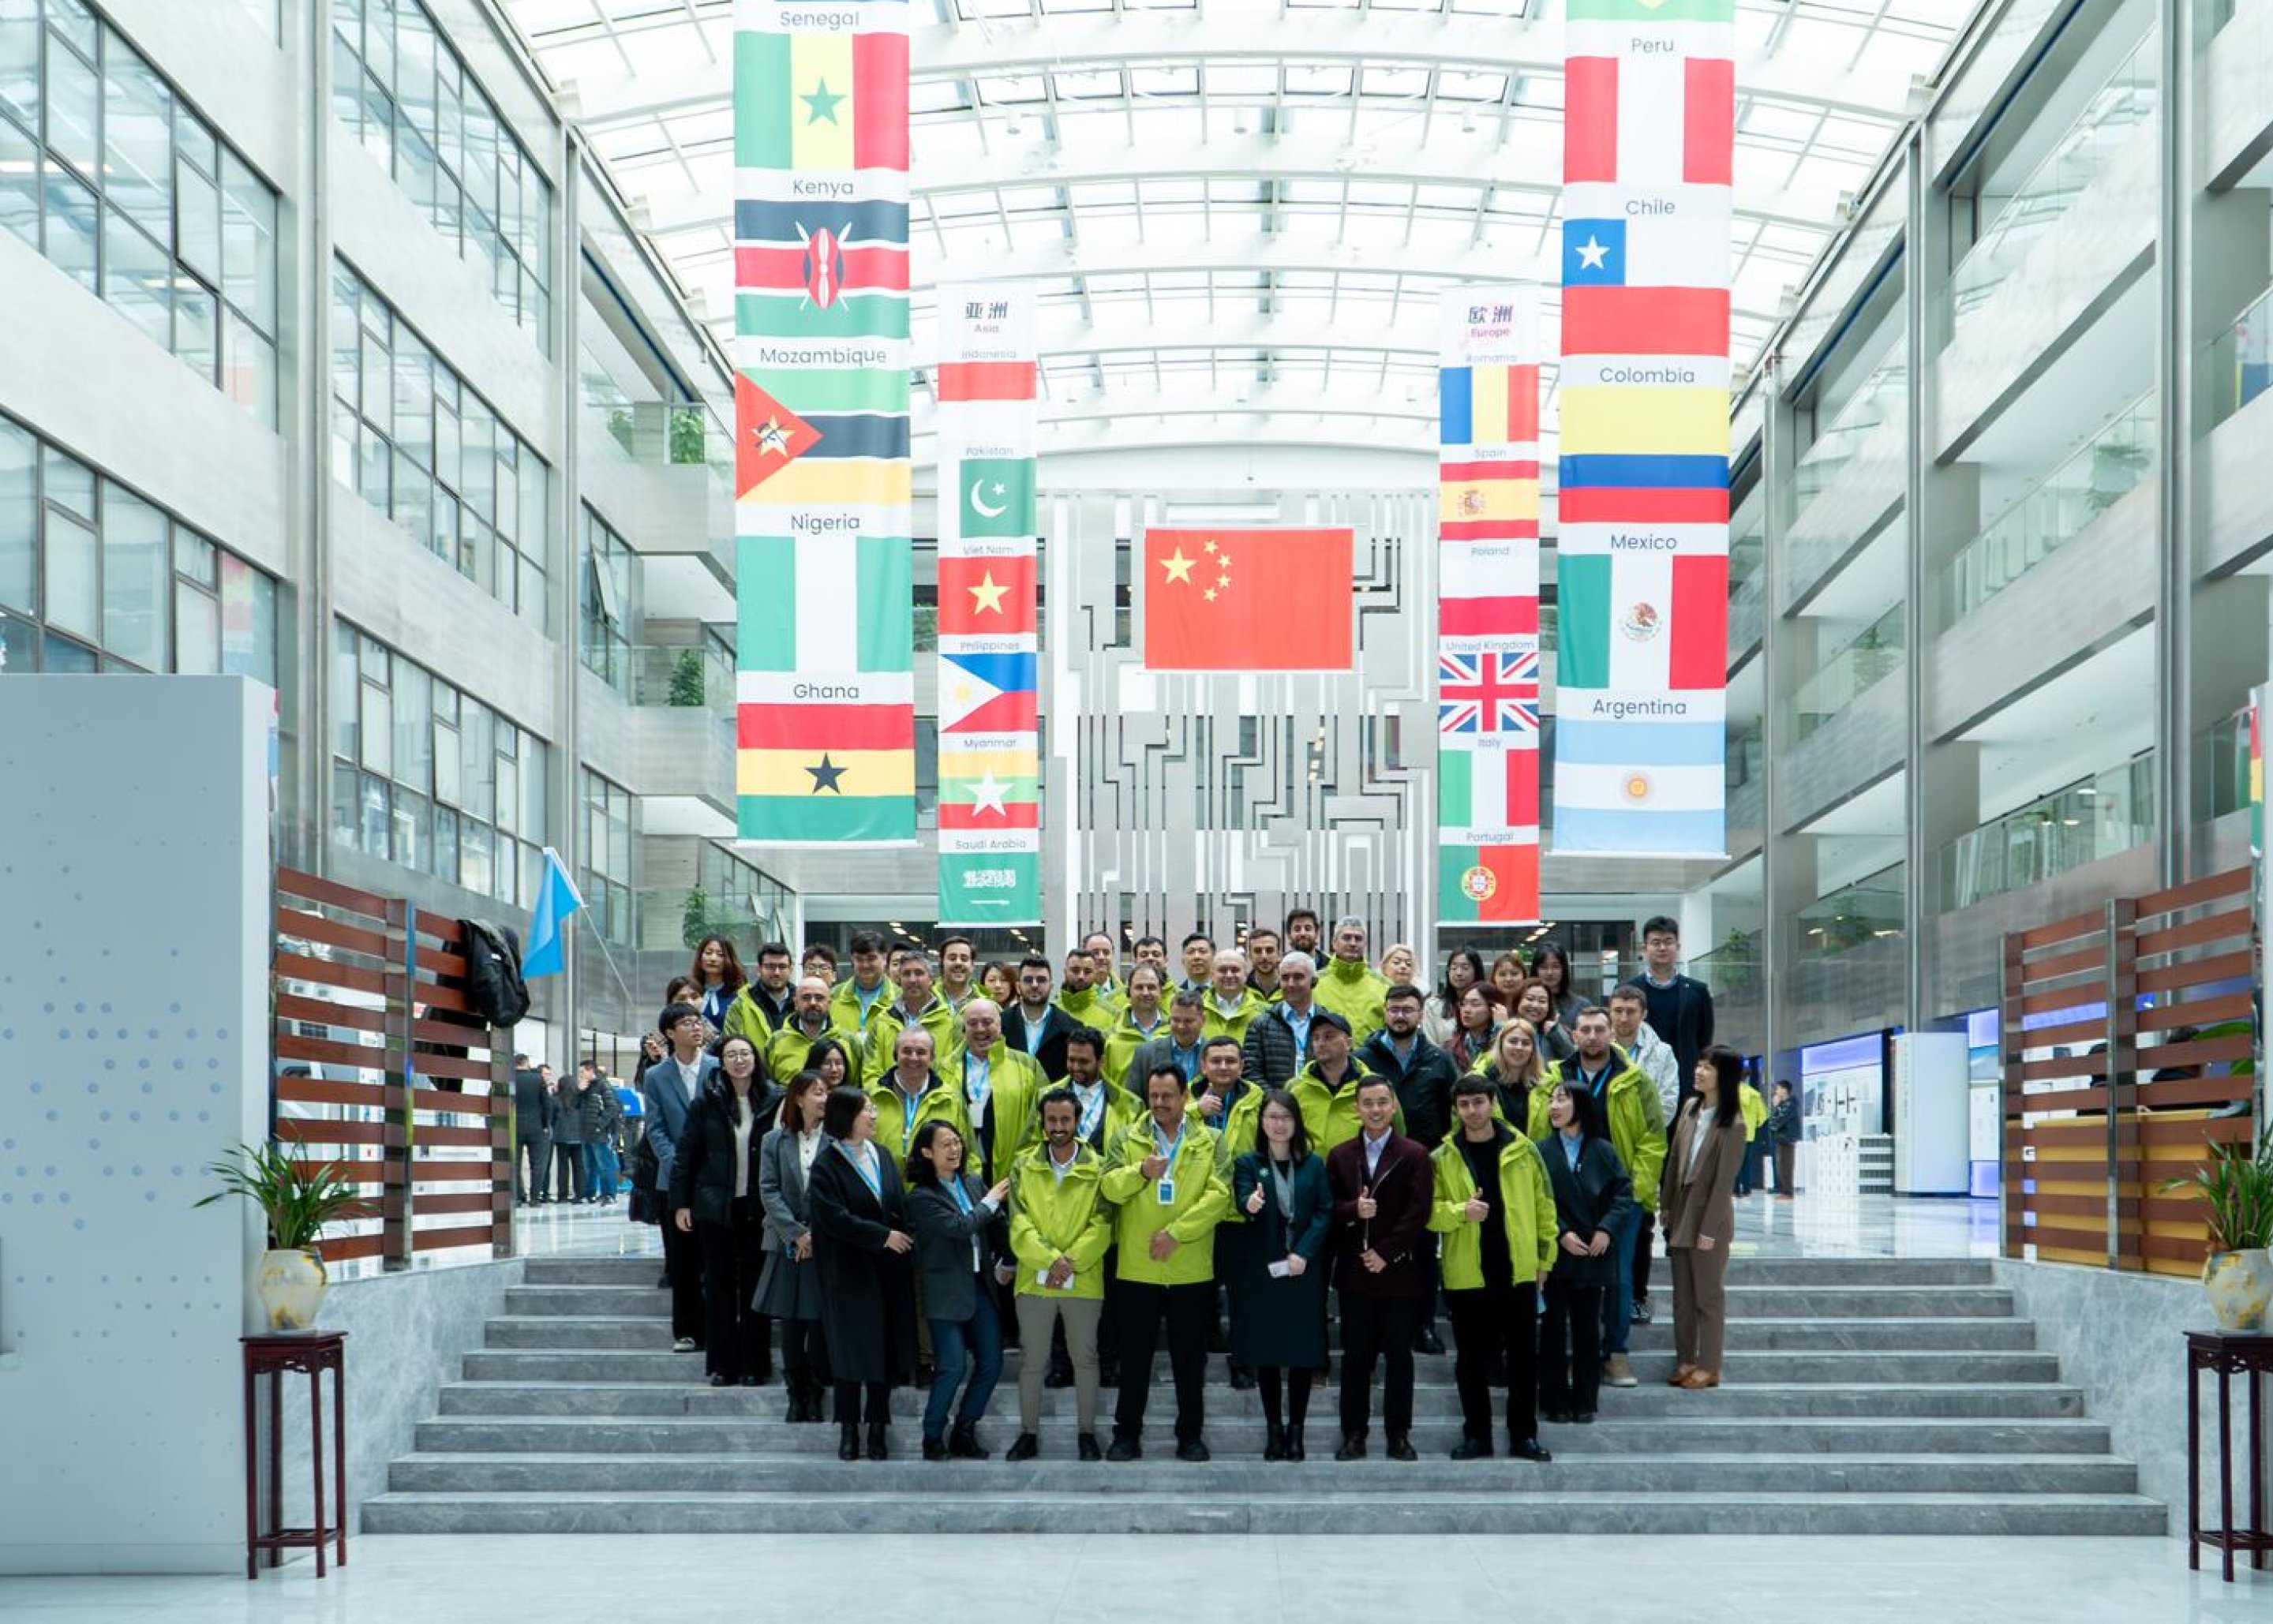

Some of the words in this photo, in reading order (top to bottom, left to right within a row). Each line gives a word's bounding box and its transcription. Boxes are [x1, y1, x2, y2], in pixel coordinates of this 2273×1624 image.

[780, 11, 859, 31] Senegal
[1632, 38, 1673, 53] Peru
[793, 180, 853, 199] Kenya
[1626, 199, 1675, 215] Chile
[965, 301, 1008, 319] 亚洲
[1468, 305, 1513, 324] 欧洲
[1471, 328, 1510, 338] Europe
[760, 348, 886, 367] Mozambique
[1600, 367, 1694, 384] Colombia
[965, 446, 1013, 455] Pakistan
[1474, 448, 1507, 458] Spain
[792, 514, 859, 534] Nigeria
[1612, 533, 1676, 549] Mexico
[1471, 546, 1509, 555] Poland
[961, 641, 1020, 651] Philippines
[1446, 641, 1481, 650] United
[1484, 641, 1534, 652] Kingdom
[793, 683, 859, 699] Ghana
[1593, 699, 1686, 719] Argentina
[964, 739, 1017, 749] Myanmar
[1478, 738, 1502, 748] Italy
[956, 840, 987, 849] Saudi
[990, 840, 1027, 849] Arabia
[1466, 833, 1514, 844] Portugal
